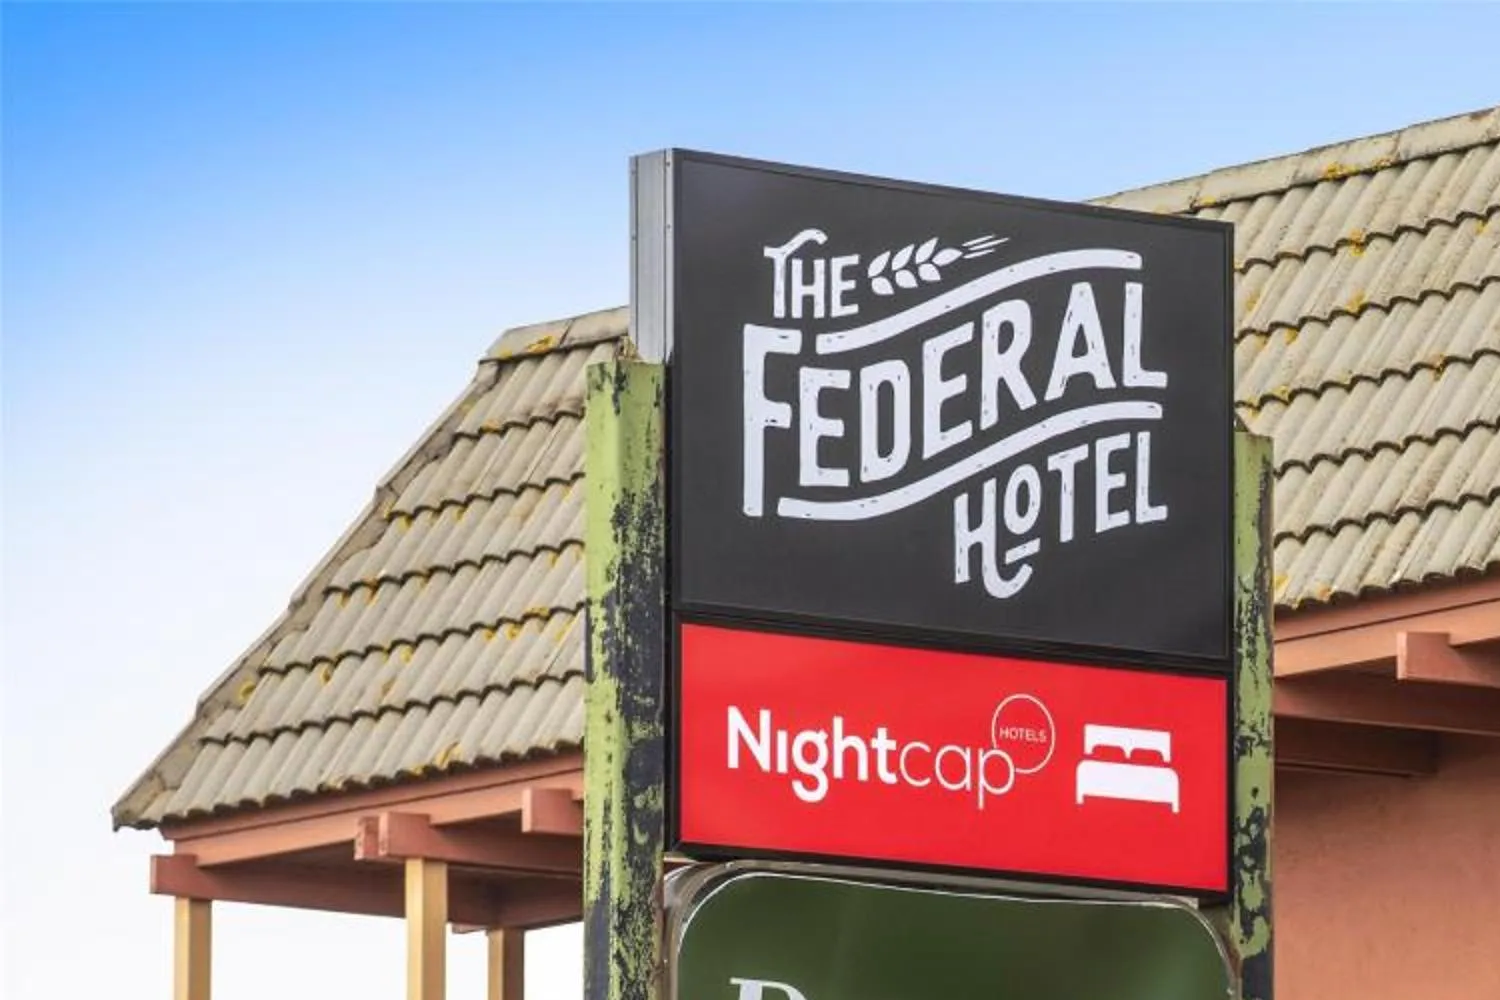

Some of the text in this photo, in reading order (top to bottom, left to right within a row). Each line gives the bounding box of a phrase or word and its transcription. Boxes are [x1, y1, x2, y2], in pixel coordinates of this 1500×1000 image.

[764, 229, 859, 318] THE
[743, 282, 1167, 516] FEDERAL
[954, 432, 1167, 598] HOTEL
[727, 706, 1015, 809] Nightcap
[999, 726, 1047, 744] HOTELS
